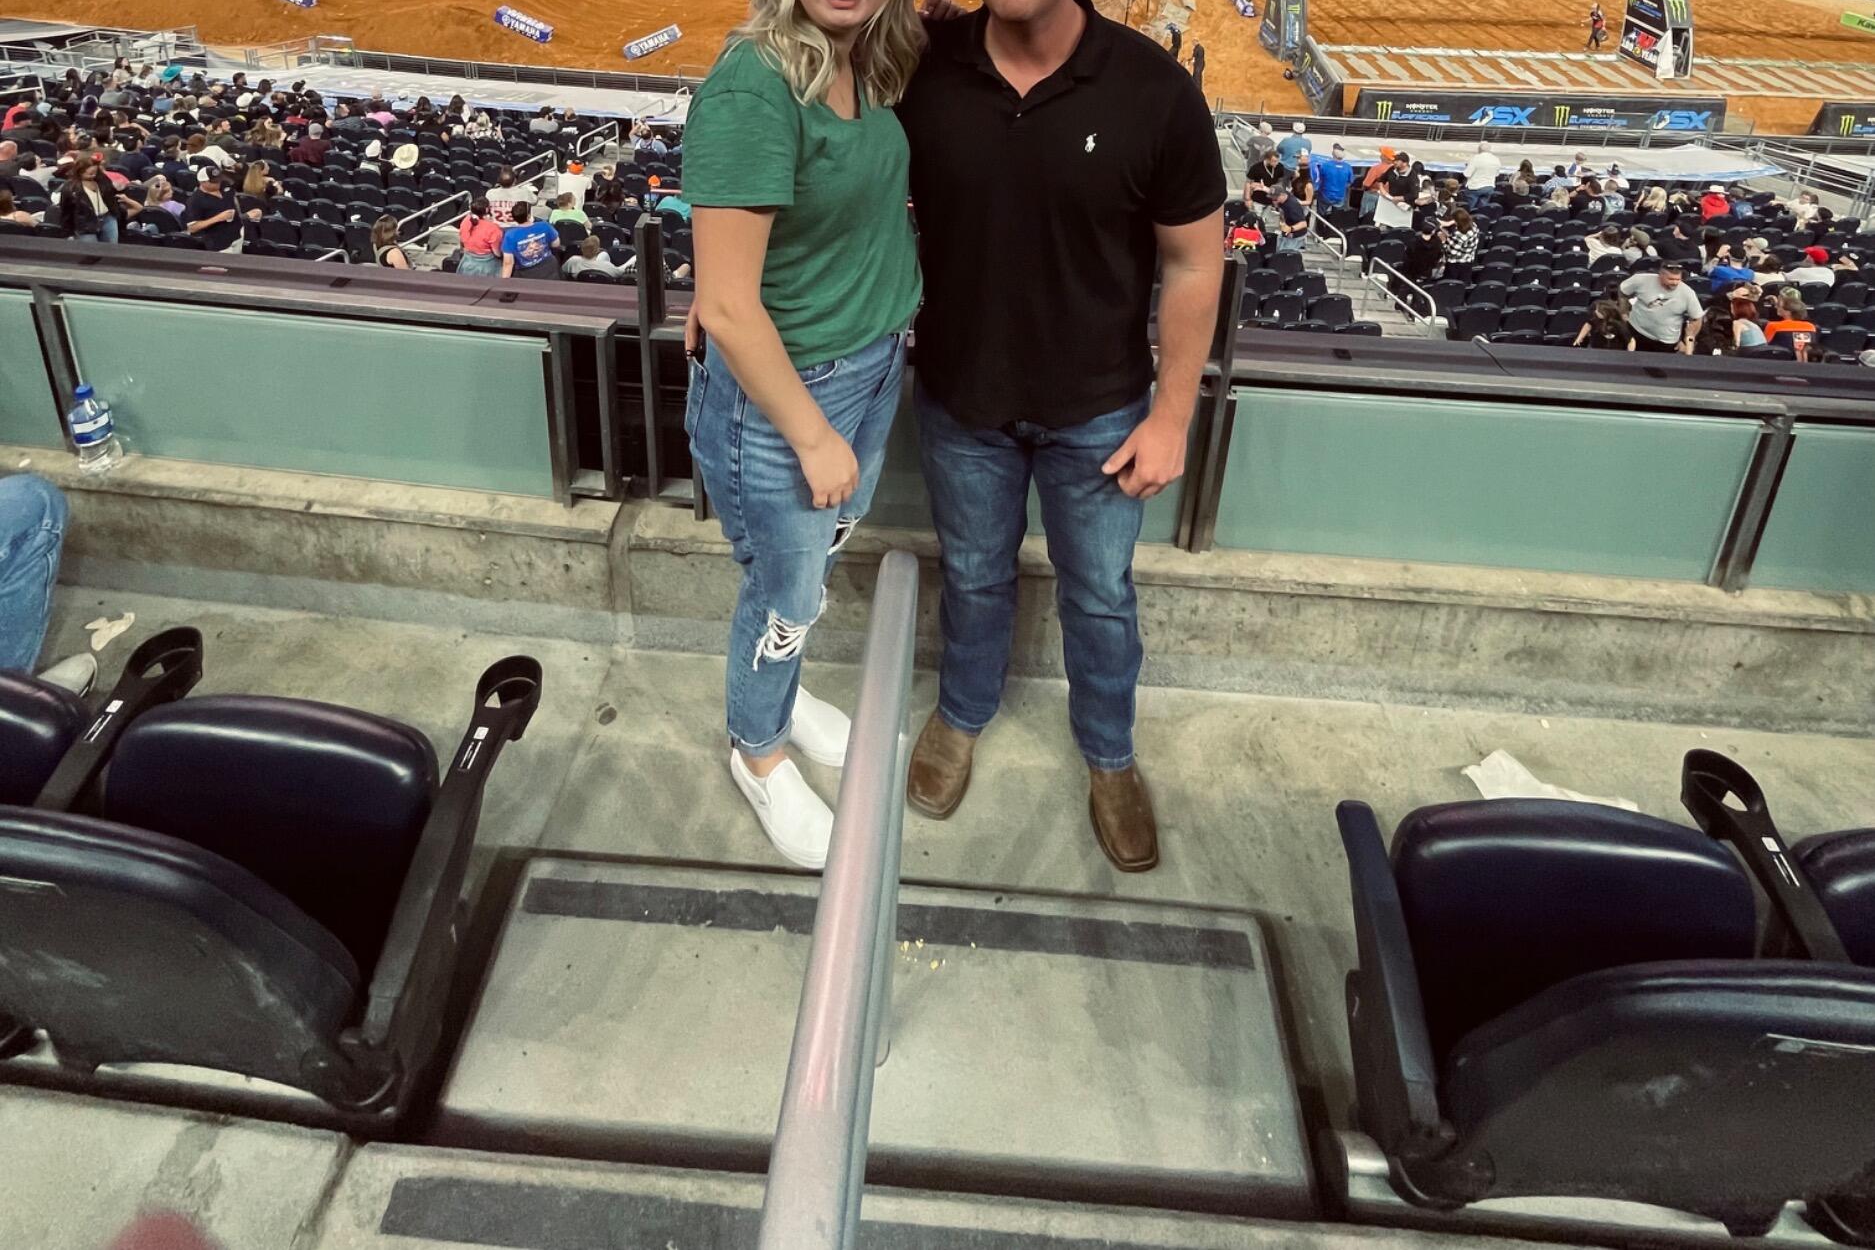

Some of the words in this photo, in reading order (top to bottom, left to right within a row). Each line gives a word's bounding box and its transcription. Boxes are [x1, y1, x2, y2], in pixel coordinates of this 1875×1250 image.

[510, 19, 541, 39] YAMAHA
[639, 31, 669, 52] YAMAHA
[1406, 103, 1438, 111] MONSTER
